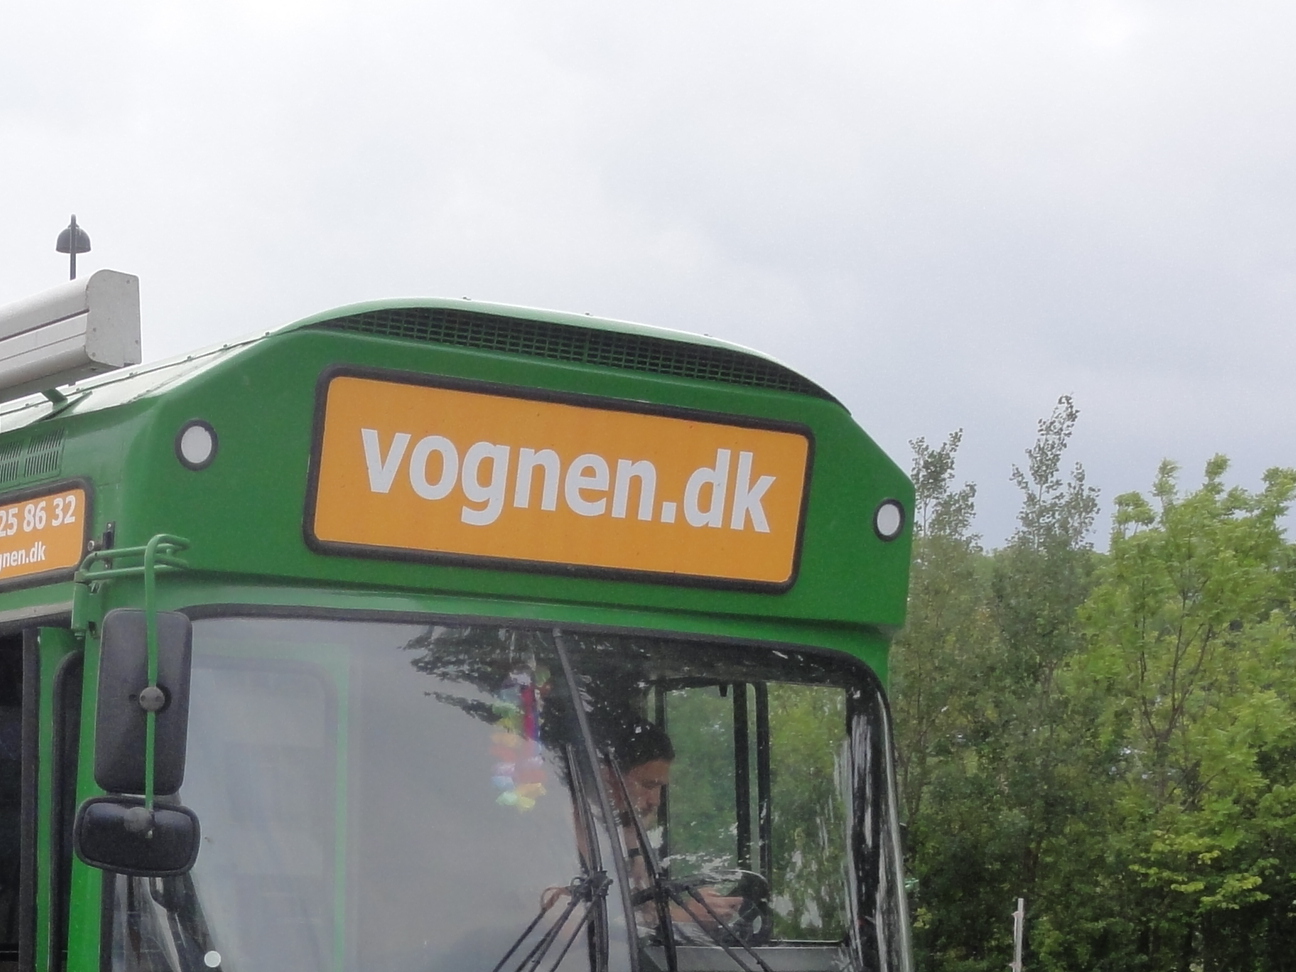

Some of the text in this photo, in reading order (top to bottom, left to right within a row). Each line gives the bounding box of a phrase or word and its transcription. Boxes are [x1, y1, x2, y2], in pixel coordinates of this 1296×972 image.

[22, 500, 47, 532] 86
[51, 494, 77, 527] 32
[360, 427, 777, 534] vognen.dk
